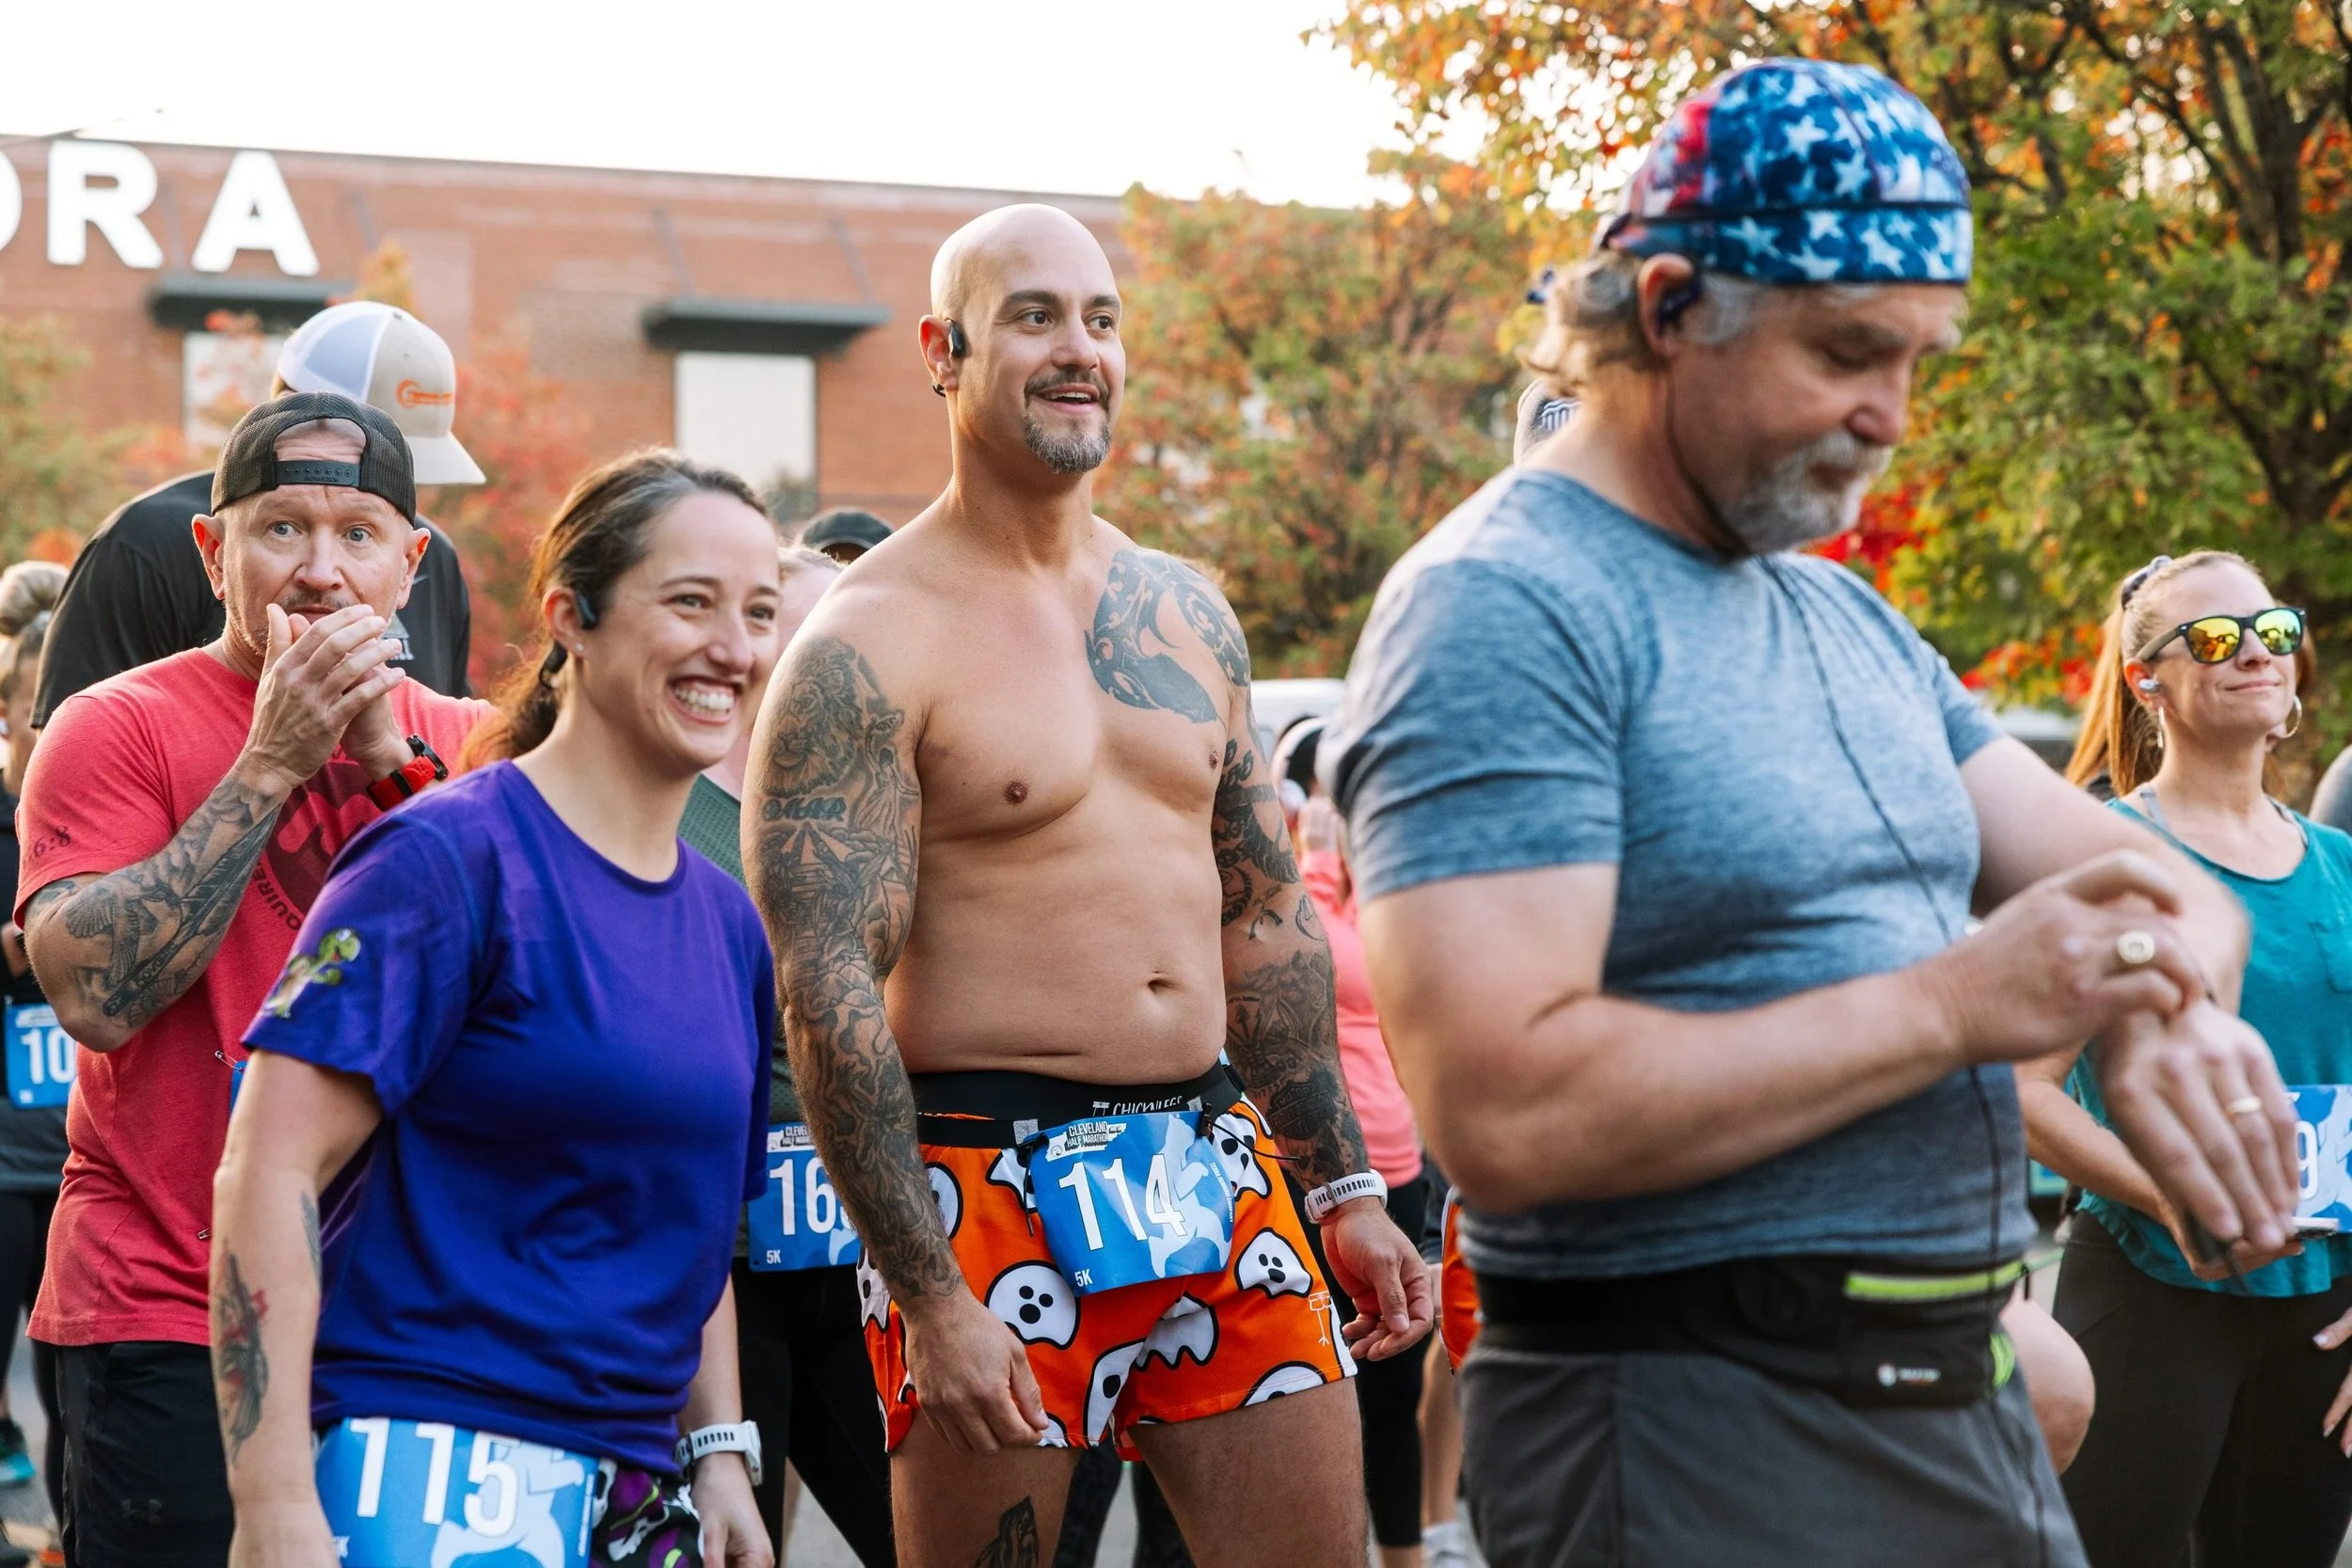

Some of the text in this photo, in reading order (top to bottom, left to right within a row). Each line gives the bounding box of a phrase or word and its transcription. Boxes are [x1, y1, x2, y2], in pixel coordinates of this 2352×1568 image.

[0, 140, 320, 277] RA
[20, 1028, 76, 1085] 10
[785, 1125, 810, 1137] CLEVE
[1068, 1120, 1108, 1136] CLEVELAND
[1067, 1133, 1109, 1148] HALF MARATHON
[1058, 1154, 1188, 1251] 114
[766, 1249, 782, 1264] 5K
[1074, 1269, 1093, 1287] 5K
[349, 1417, 519, 1538] 115
